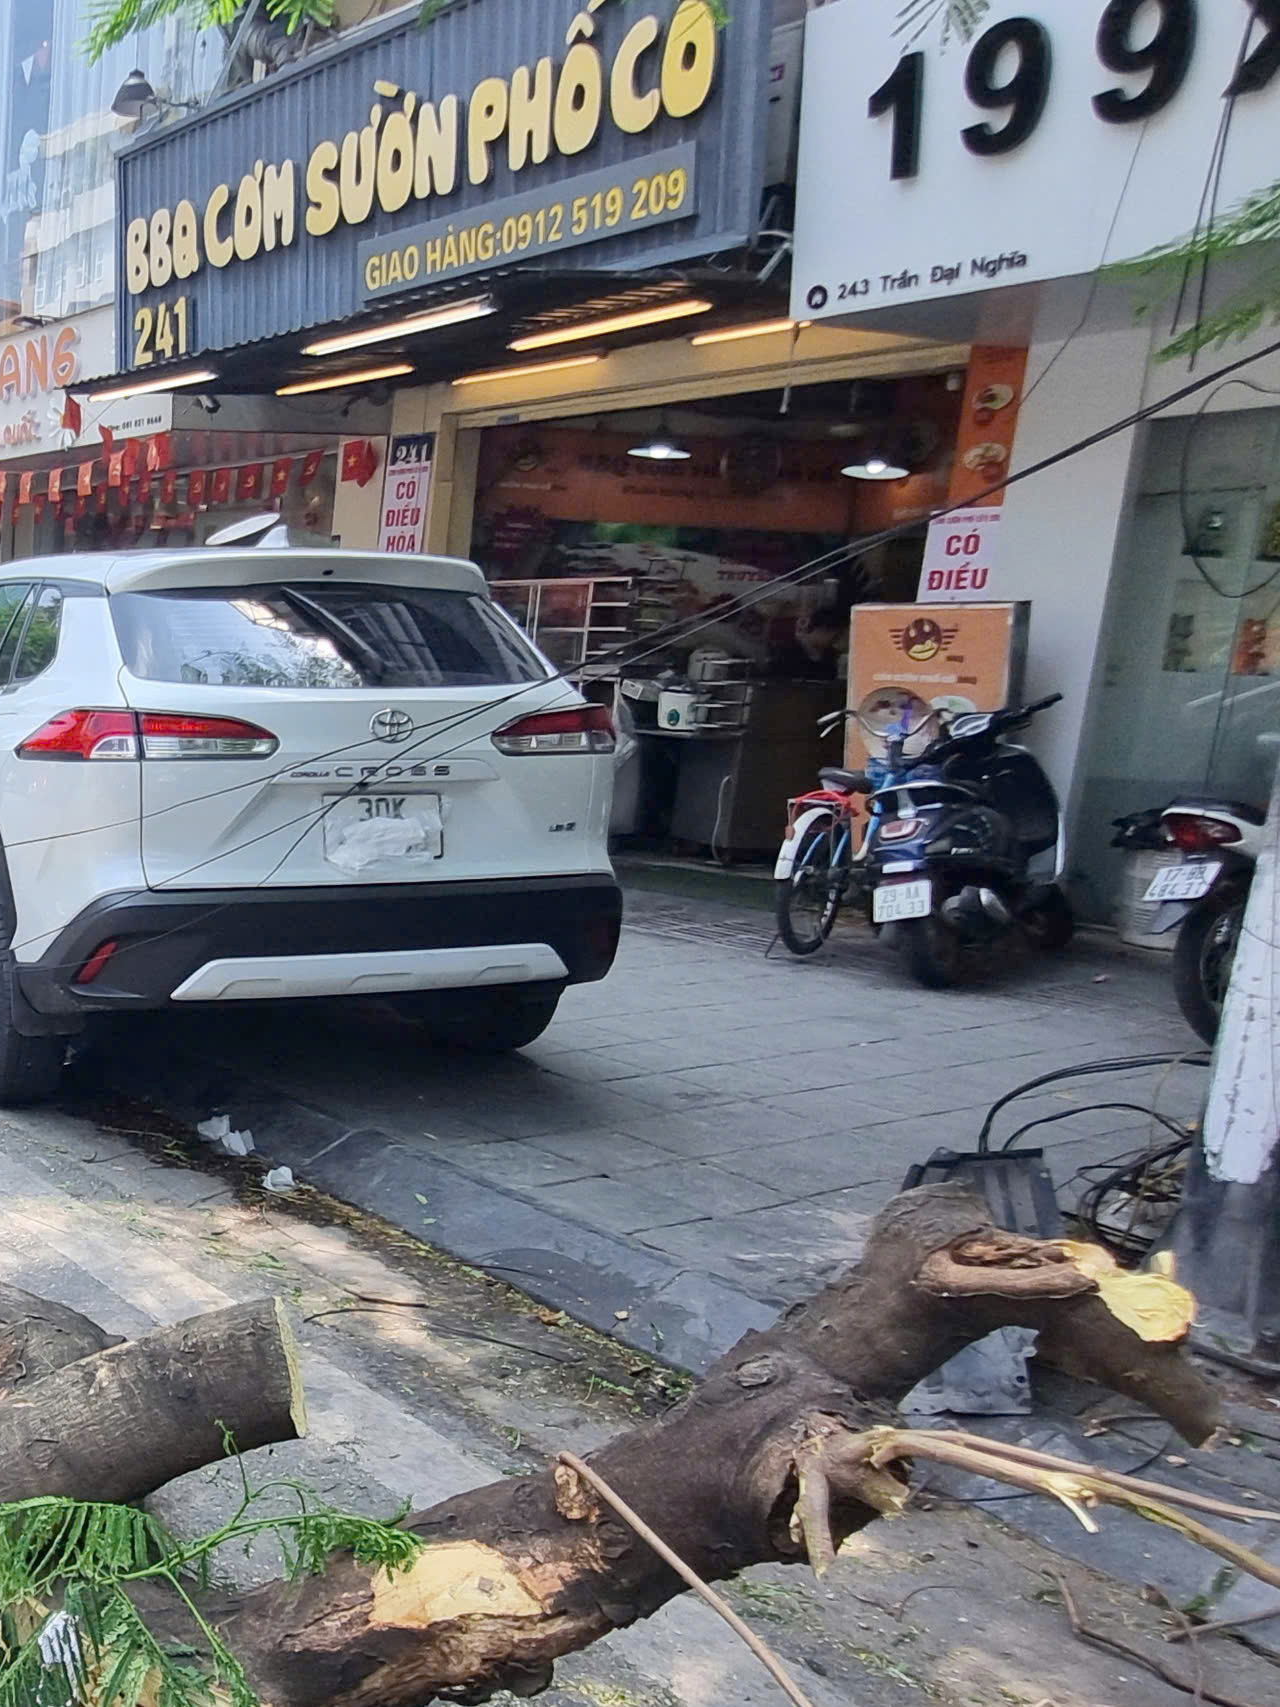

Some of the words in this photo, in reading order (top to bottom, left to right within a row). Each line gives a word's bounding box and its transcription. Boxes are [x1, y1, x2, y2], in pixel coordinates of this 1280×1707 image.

[127, 200, 200, 295] BBQ
[204, 159, 295, 268] CƠM
[306, 80, 458, 236] SƯỜN
[365, 245, 419, 292] GIAO
[571, 186, 624, 237] 519
[631, 167, 688, 222] 209
[837, 279, 870, 301] 243
[880, 269, 919, 294] Trần
[930, 262, 962, 286] Đại
[971, 250, 1028, 279] Nghĩa
[133, 296, 189, 367] 241
[395, 442, 430, 465] 241
[395, 475, 417, 500] CÓ
[945, 527, 982, 556] CÓ
[334, 765, 451, 778] CROSS
